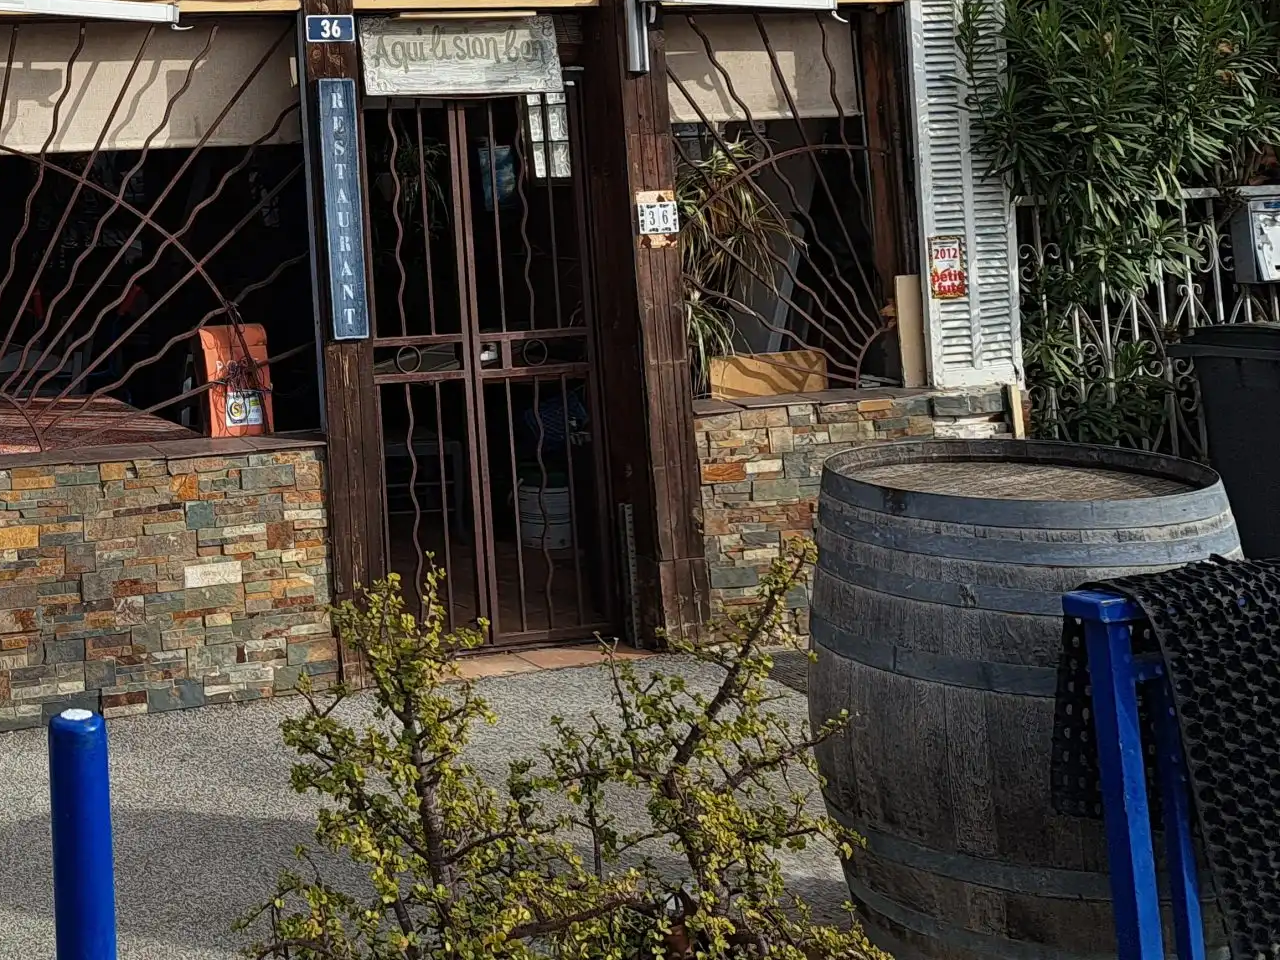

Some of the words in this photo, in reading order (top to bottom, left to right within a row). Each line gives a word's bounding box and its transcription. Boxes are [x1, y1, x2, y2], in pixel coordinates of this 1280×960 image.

[320, 19, 342, 38] 36
[329, 91, 357, 327] RESTAURANT
[648, 210, 669, 226] 36
[933, 247, 959, 260] 2012
